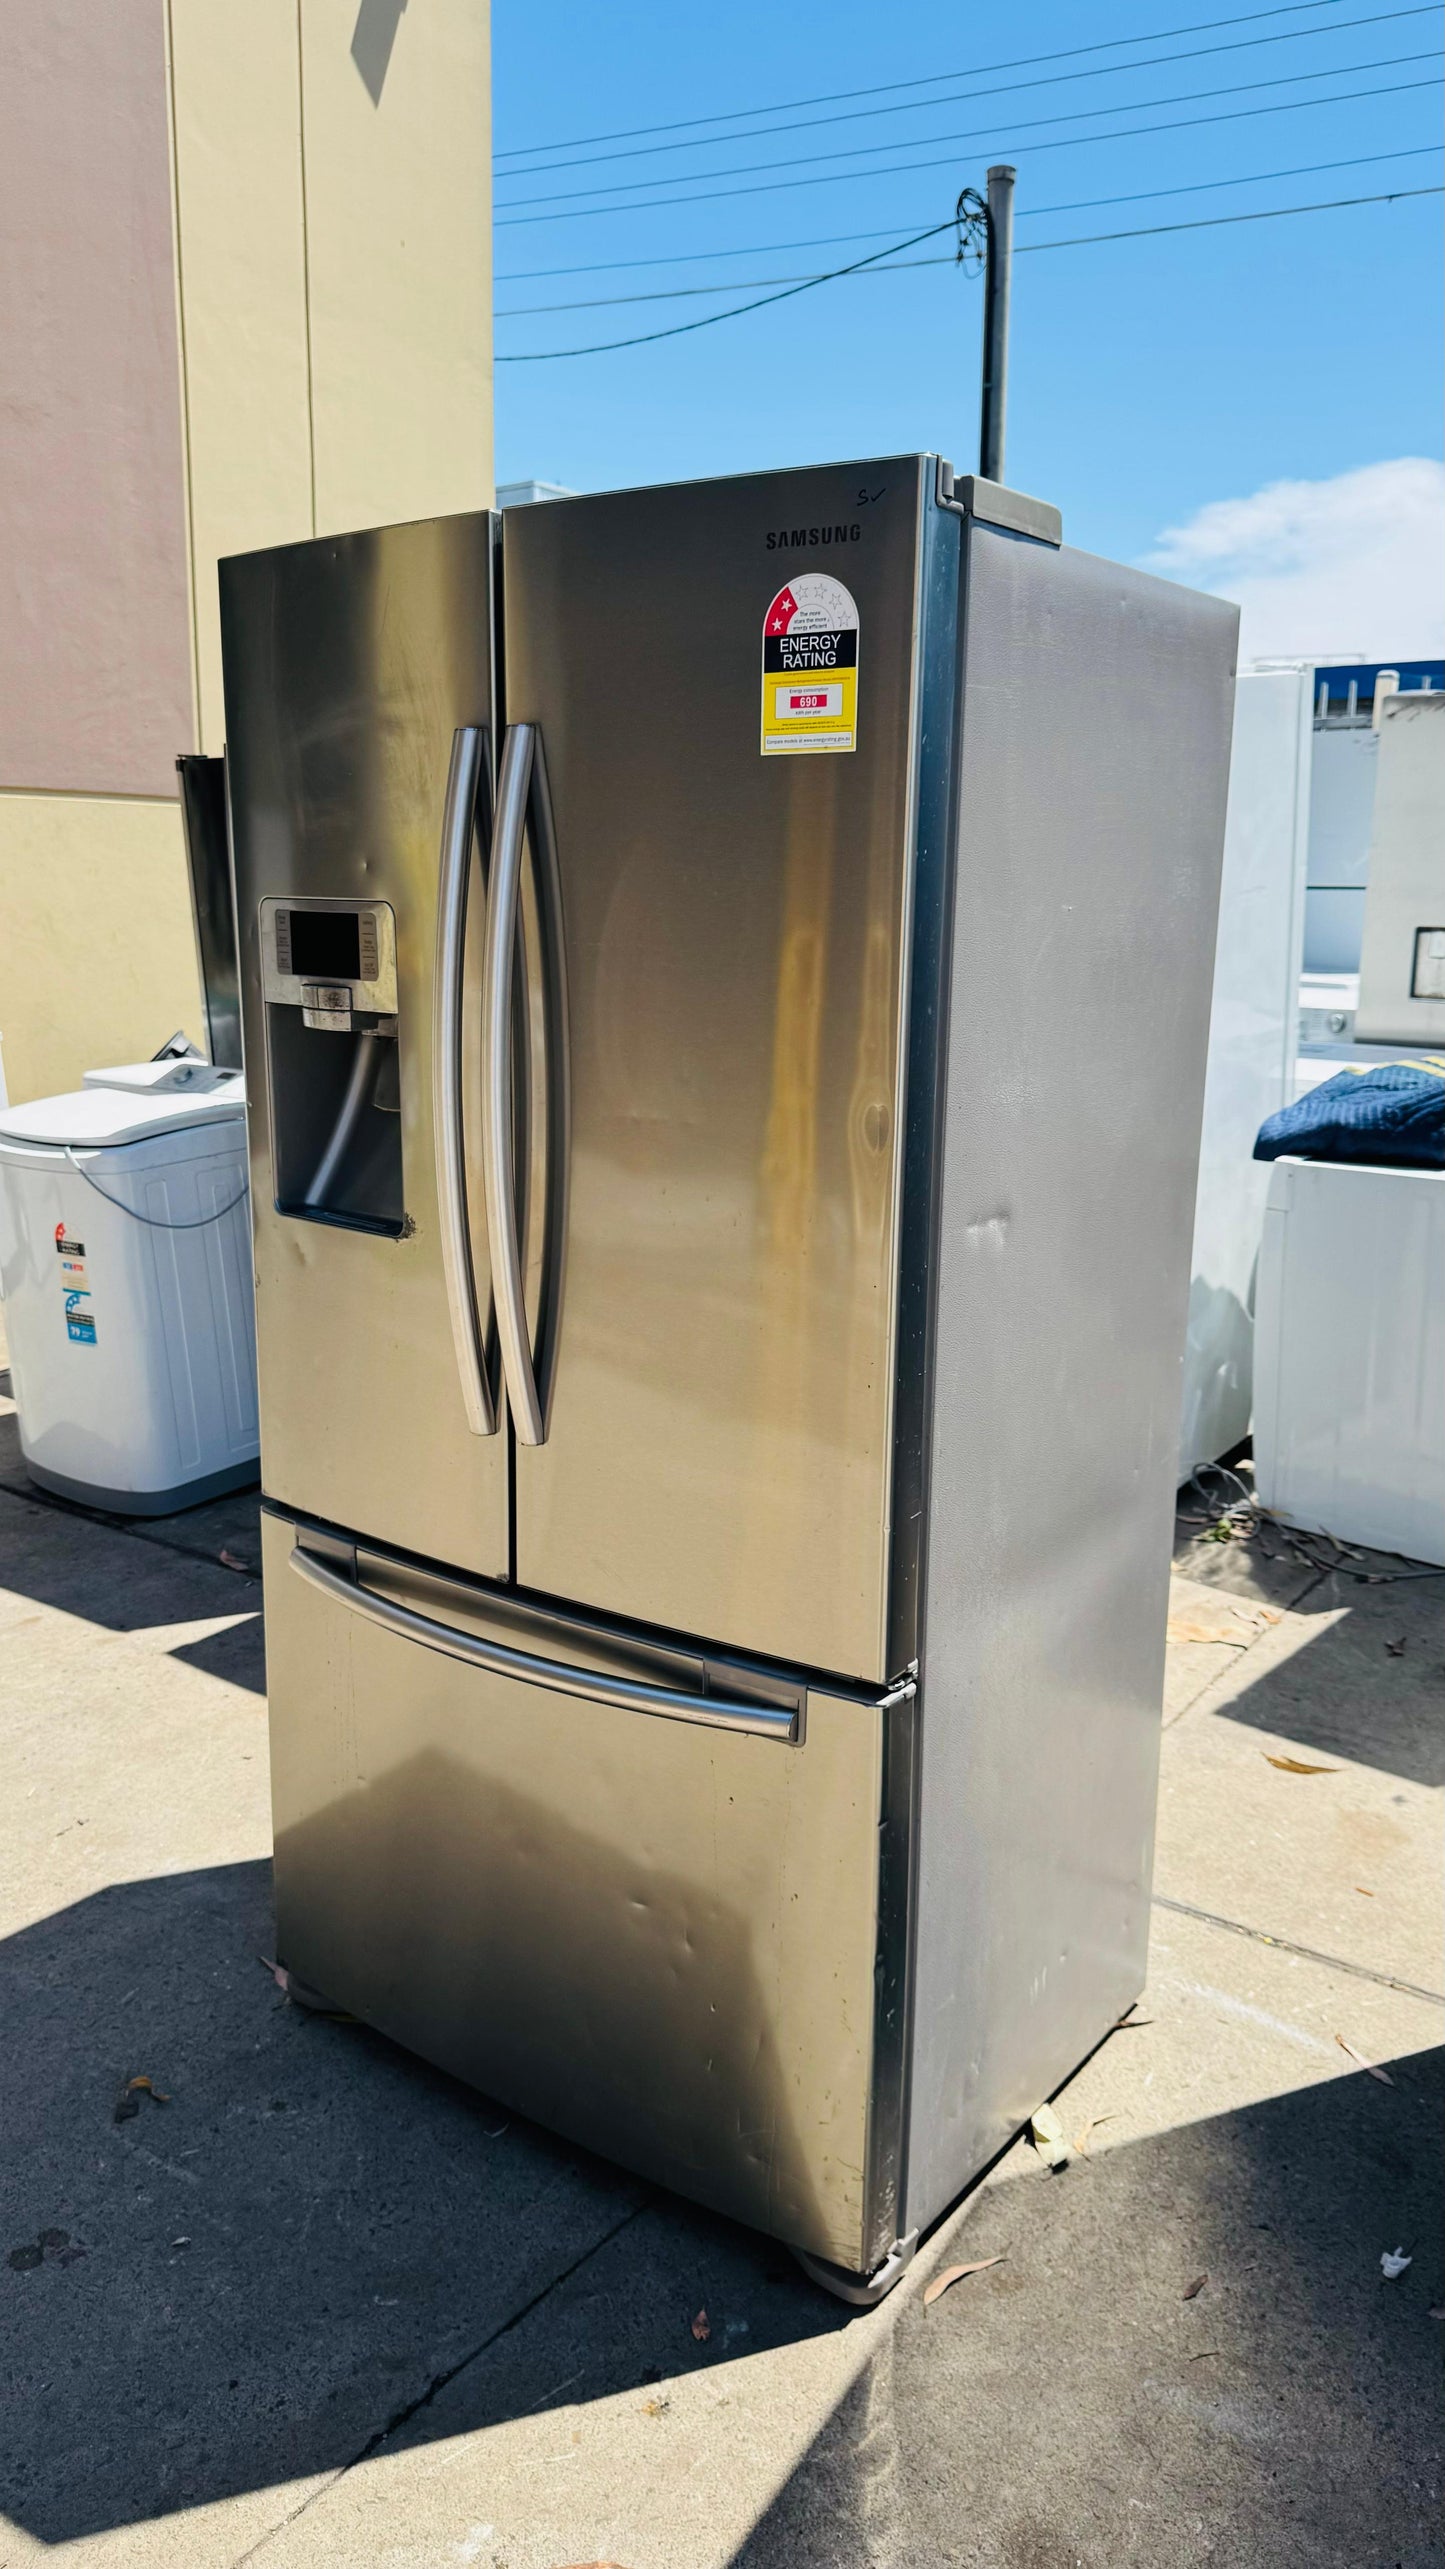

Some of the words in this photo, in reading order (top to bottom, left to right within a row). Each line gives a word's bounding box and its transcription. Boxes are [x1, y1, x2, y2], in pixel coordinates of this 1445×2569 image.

[766, 524, 861, 550] SAMSUNG
[780, 634, 841, 653] ENERGY
[783, 652, 837, 669] RATING
[800, 696, 817, 707] 690
